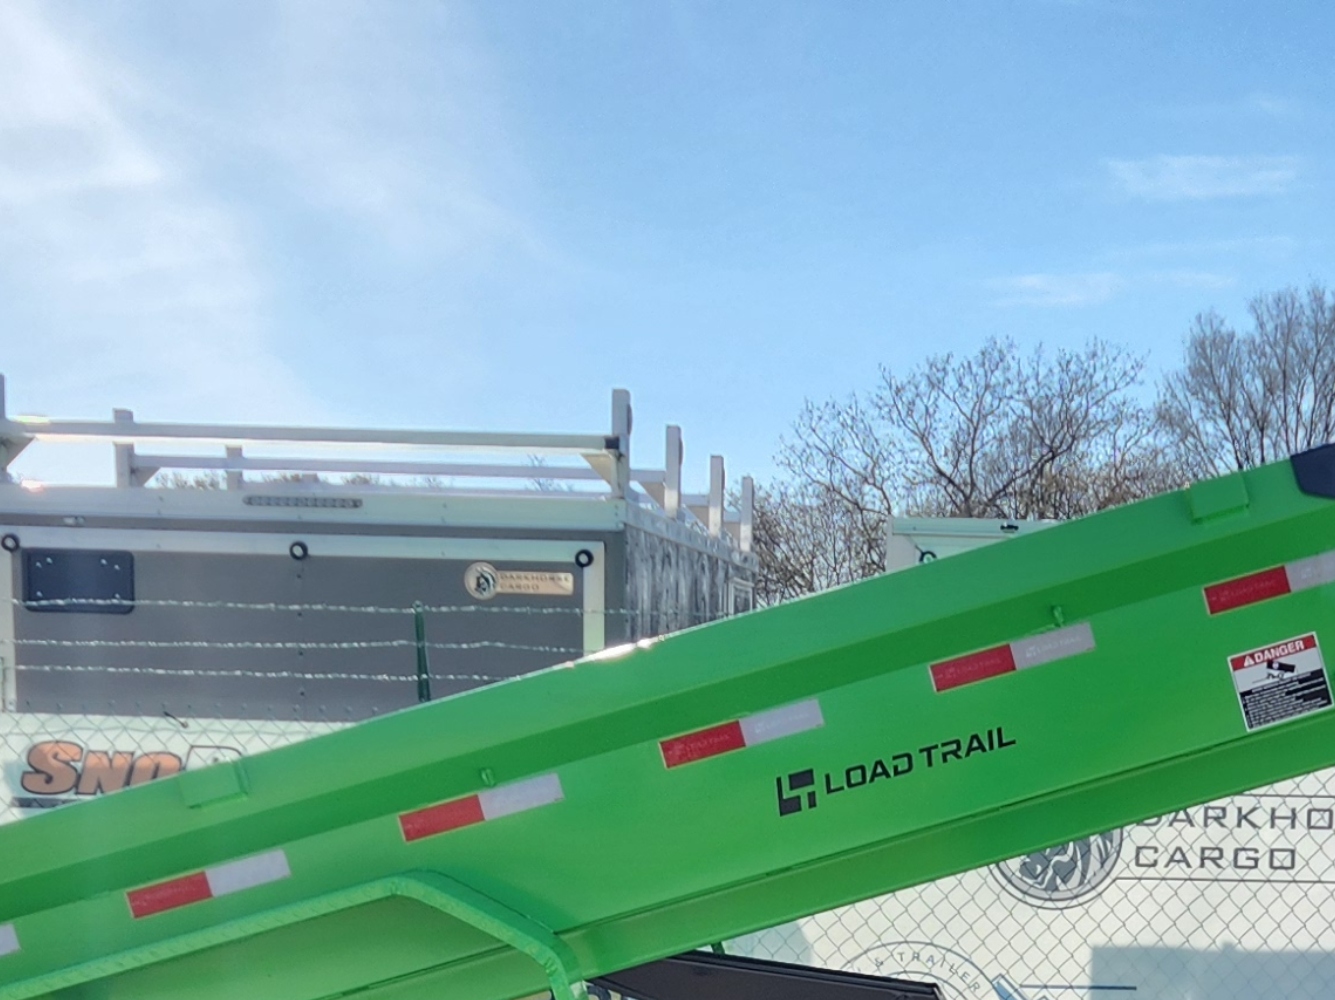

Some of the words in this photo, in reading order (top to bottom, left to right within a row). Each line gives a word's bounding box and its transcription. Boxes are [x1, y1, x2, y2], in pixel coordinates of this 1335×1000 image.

[1253, 639, 1305, 664] DANGER
[824, 752, 914, 795] LOAD
[918, 726, 1017, 768] TRAIL
[1134, 845, 1297, 871] CARGO
[897, 951, 982, 994] TRAILER
